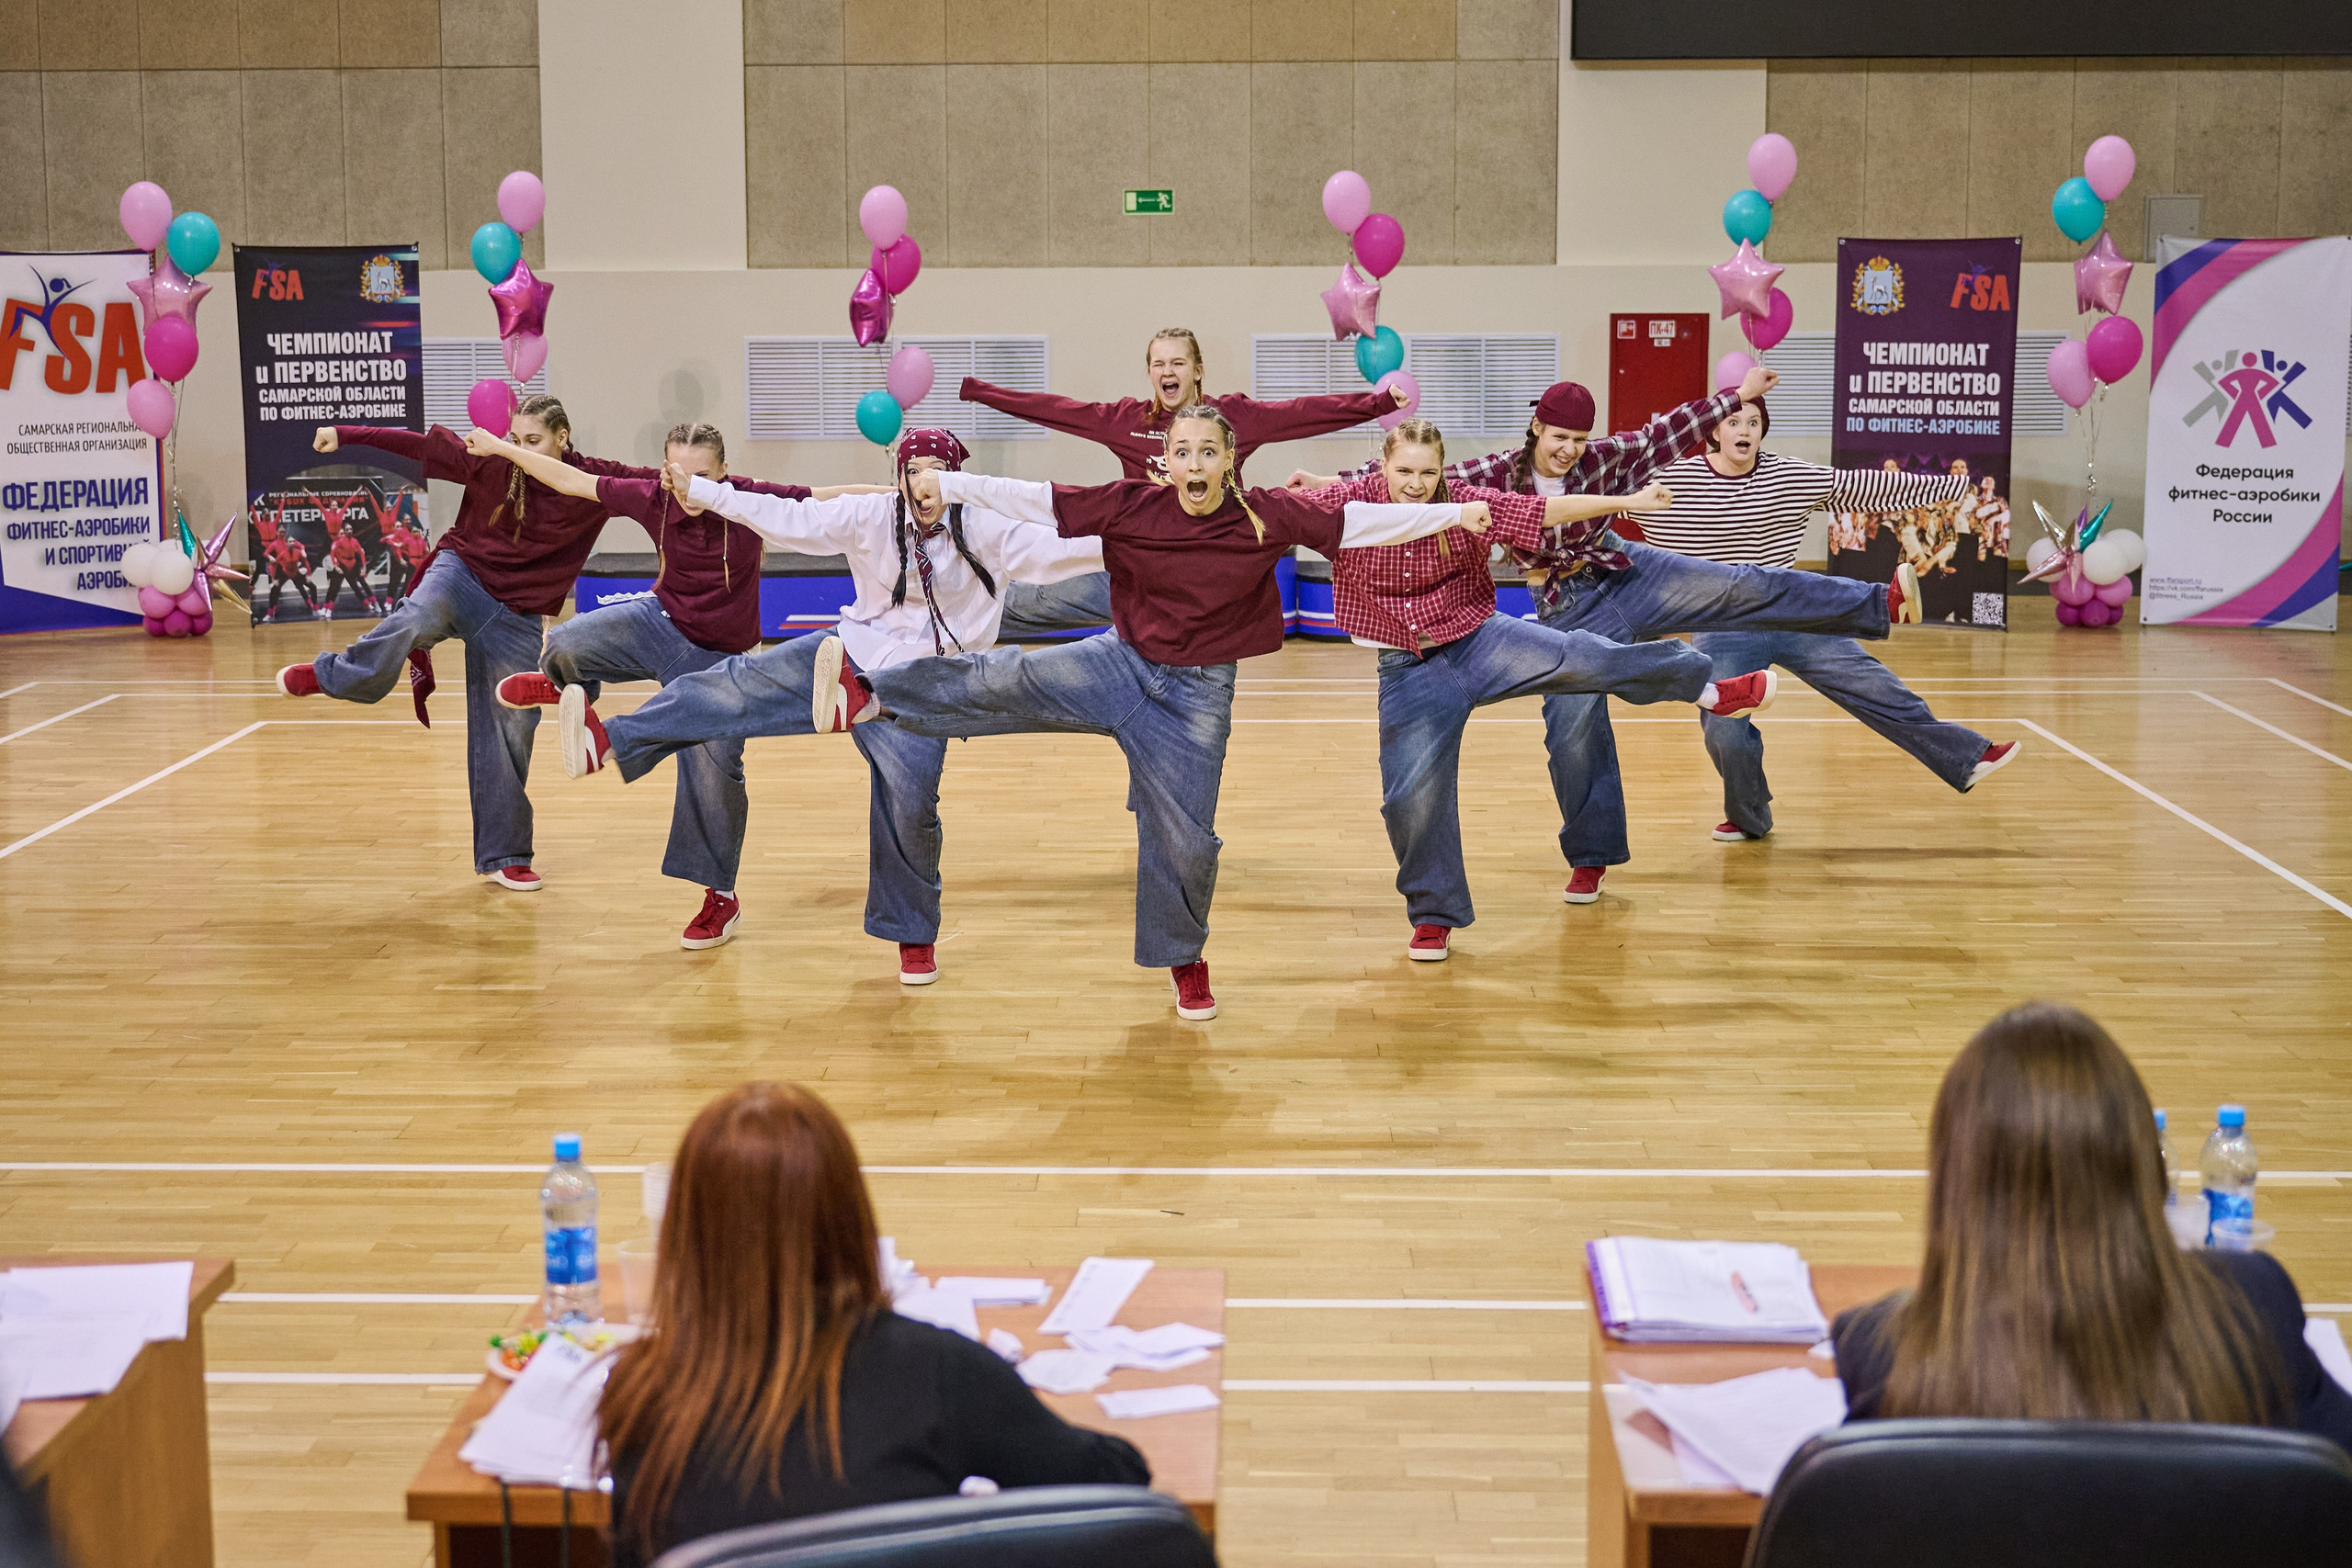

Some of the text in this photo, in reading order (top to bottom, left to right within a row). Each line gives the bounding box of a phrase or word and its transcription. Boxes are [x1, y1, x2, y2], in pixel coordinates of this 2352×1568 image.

[252, 269, 304, 301] FSA
[1950, 272, 2010, 311] FSA
[0, 299, 146, 395] FSA
[267, 332, 393, 355] ЧЕМПИОНАТ
[1863, 342, 1990, 366] ЧЕМПИОНАТ
[274, 358, 407, 384] ПЕРВЕНСТВО
[1867, 371, 2001, 396] ПЕРВЕНСТВО
[259, 386, 406, 403] САМАРСКОЙ ОБЛАСТИ
[260, 404, 406, 421] ПО ФИТНЕС-АЭРОБИКЕ
[1849, 398, 2000, 416] САМАРСКОЙ ОБЛАСТИ
[18, 421, 141, 436] САМАРСКАЯ РЕГИОНАЛЬНА
[1847, 416, 2000, 435] ПО ФИТНЕС-АЭРОБИКЕ
[7, 438, 147, 455] ОБЩЕСТВЕННАЯ ОРГАНИЗАЦИЯ
[2196, 464, 2294, 481] Федерация
[3, 478, 149, 513] ФЕДЕРАЦИЯ
[2168, 486, 2321, 504] фитнес-аэробики
[2213, 509, 2273, 524] России
[6, 516, 151, 540] ФИТНЕС-АЭРОБИКИ
[46, 547, 55, 565] И
